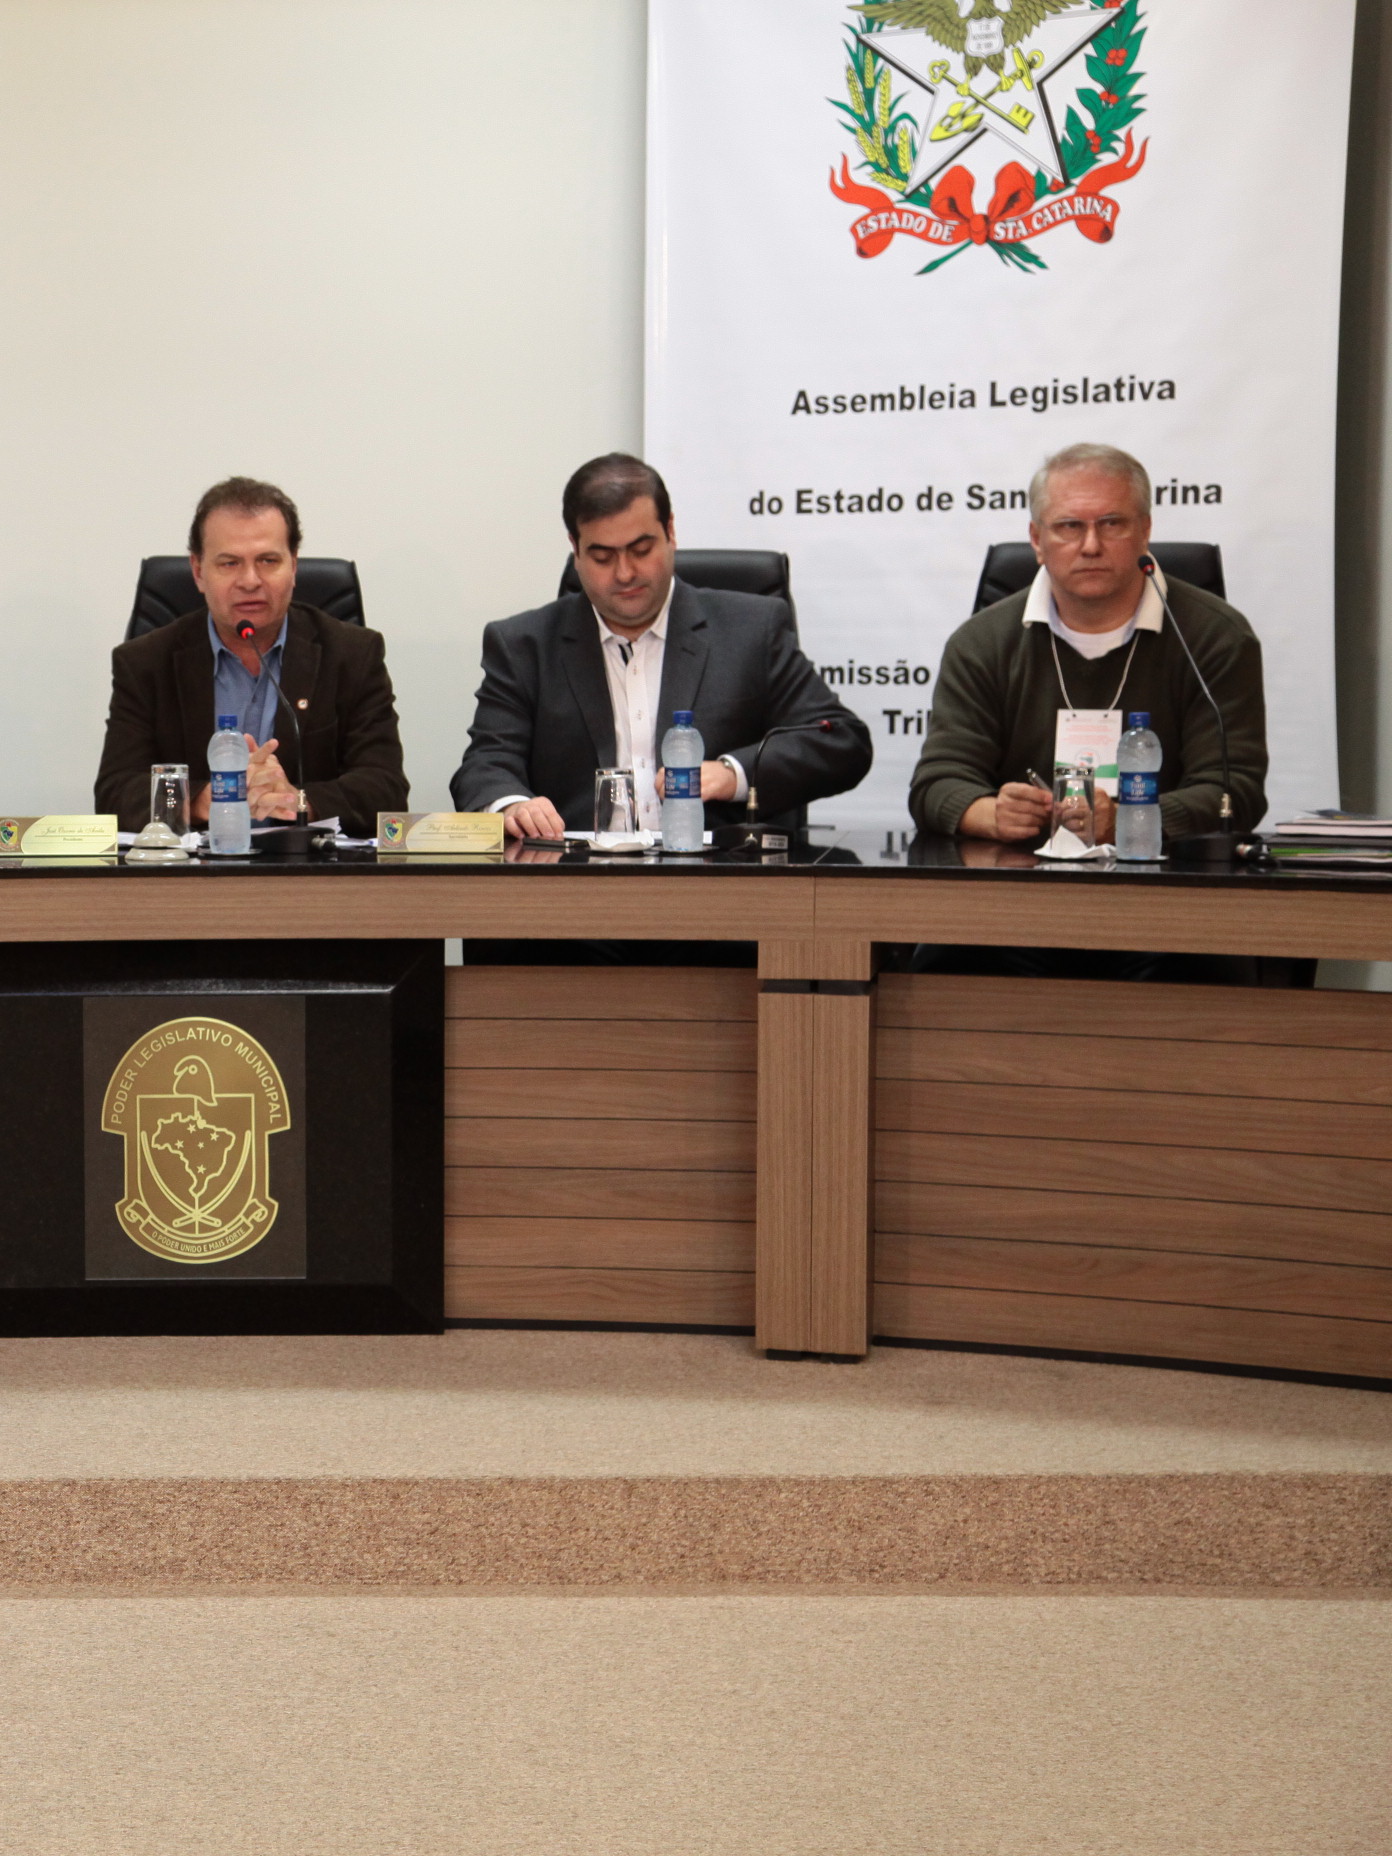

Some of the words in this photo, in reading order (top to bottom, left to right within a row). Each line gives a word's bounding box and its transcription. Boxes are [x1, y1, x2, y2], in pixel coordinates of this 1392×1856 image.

[856, 212, 928, 239] ESTADO
[927, 224, 956, 242] DE
[993, 221, 1031, 241] STA.
[1031, 195, 1114, 229] CATARINA
[790, 383, 977, 415] Assembleia
[989, 375, 1176, 413] Legislativa
[749, 490, 784, 515] do
[795, 487, 904, 514] Estado
[916, 486, 954, 512] de
[966, 484, 1028, 511] San
[1155, 478, 1223, 506] rina
[819, 659, 931, 685] missão
[882, 708, 933, 735] Tri
[110, 1068, 139, 1125] PODER
[133, 1027, 233, 1069] LEGISLATIVO
[234, 1041, 282, 1124] MUNICIPAL
[151, 1230, 158, 1239] O
[157, 1234, 179, 1250] PODER
[180, 1243, 202, 1253] UNIDO
[208, 1240, 225, 1251] MAIS
[225, 1227, 246, 1244] FORTE
